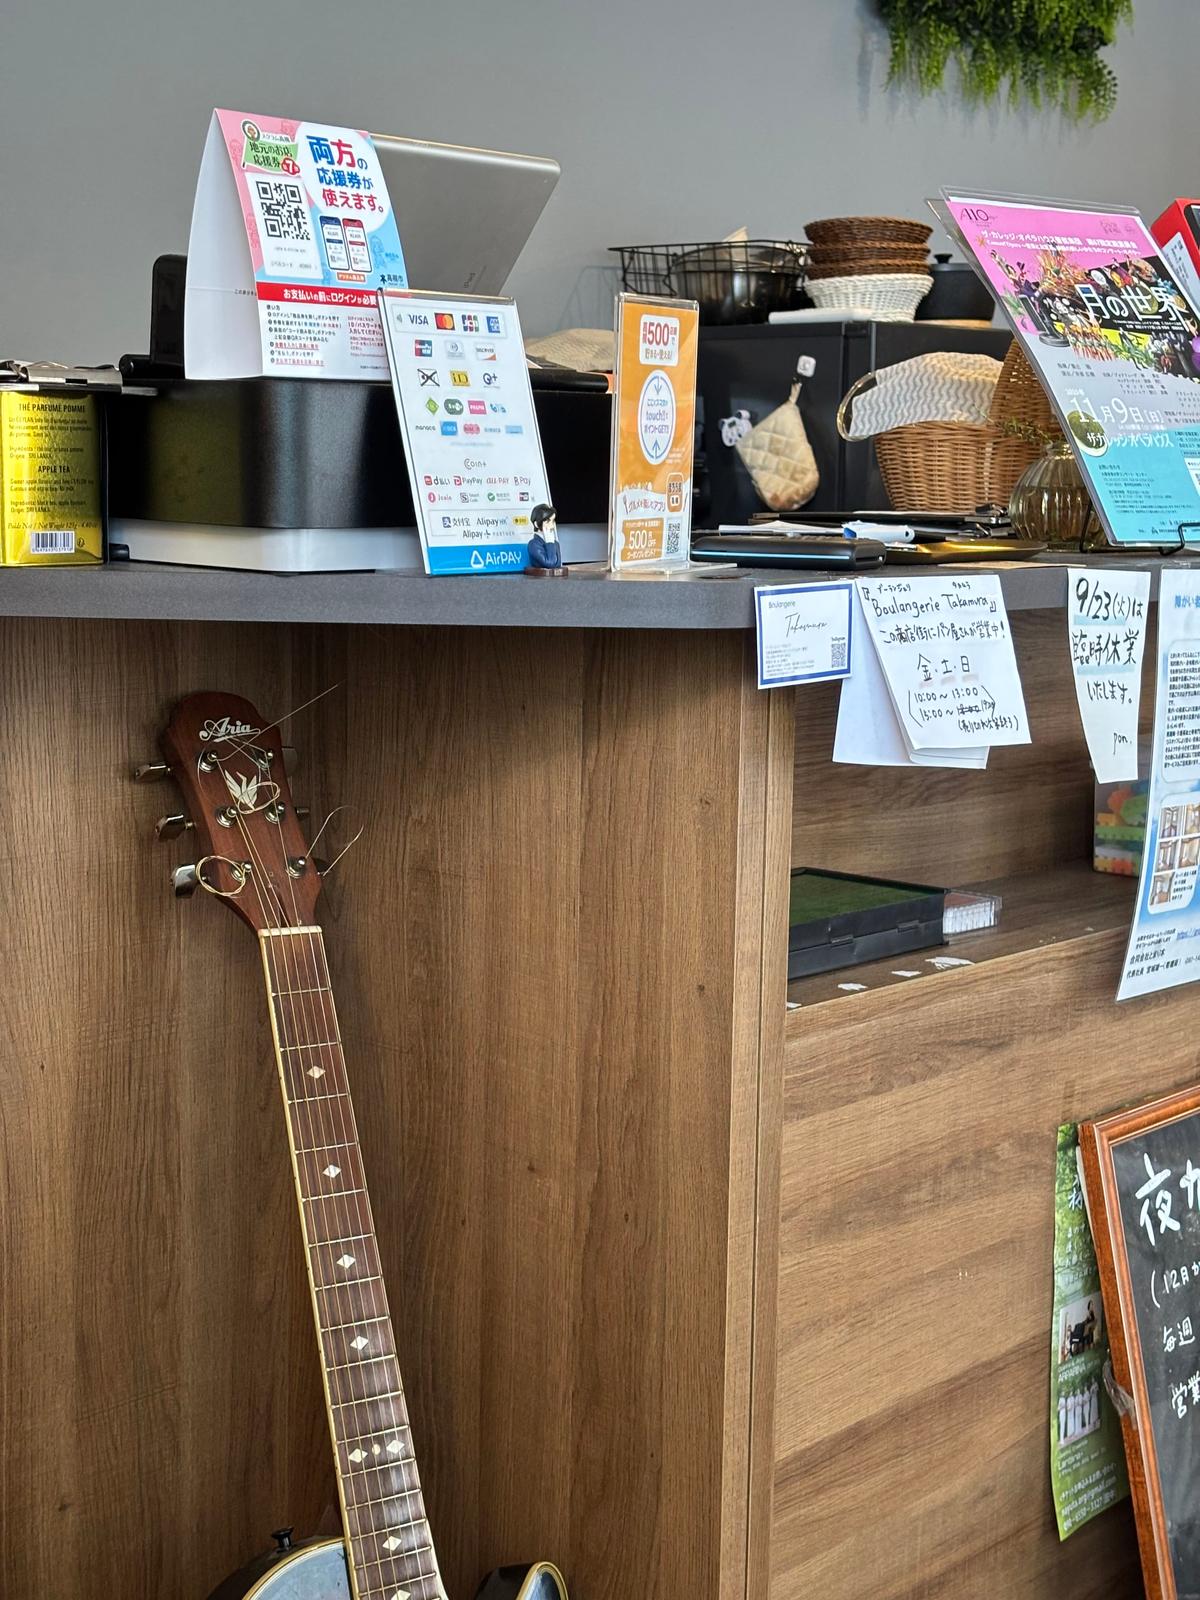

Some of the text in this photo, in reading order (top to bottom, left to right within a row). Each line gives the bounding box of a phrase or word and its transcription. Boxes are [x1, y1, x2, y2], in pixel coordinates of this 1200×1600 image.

[305, 134, 368, 170] 両方の
[316, 167, 374, 189] 応援券が
[321, 188, 385, 213] 使えます。
[408, 313, 429, 326] VISA
[1074, 283, 1190, 333] 月の世界
[647, 321, 670, 347] 500
[63, 404, 86, 413] POMME
[38, 465, 71, 474] APPLE TEA
[462, 477, 483, 486] PayPay
[628, 529, 648, 551] 500
[1075, 577, 1144, 621] 9/23(火)は
[1071, 628, 1140, 667] 臨時休業
[1086, 679, 1133, 704] いたします。
[199, 717, 261, 743] Aria
[1162, 1316, 1196, 1353] 毎週
